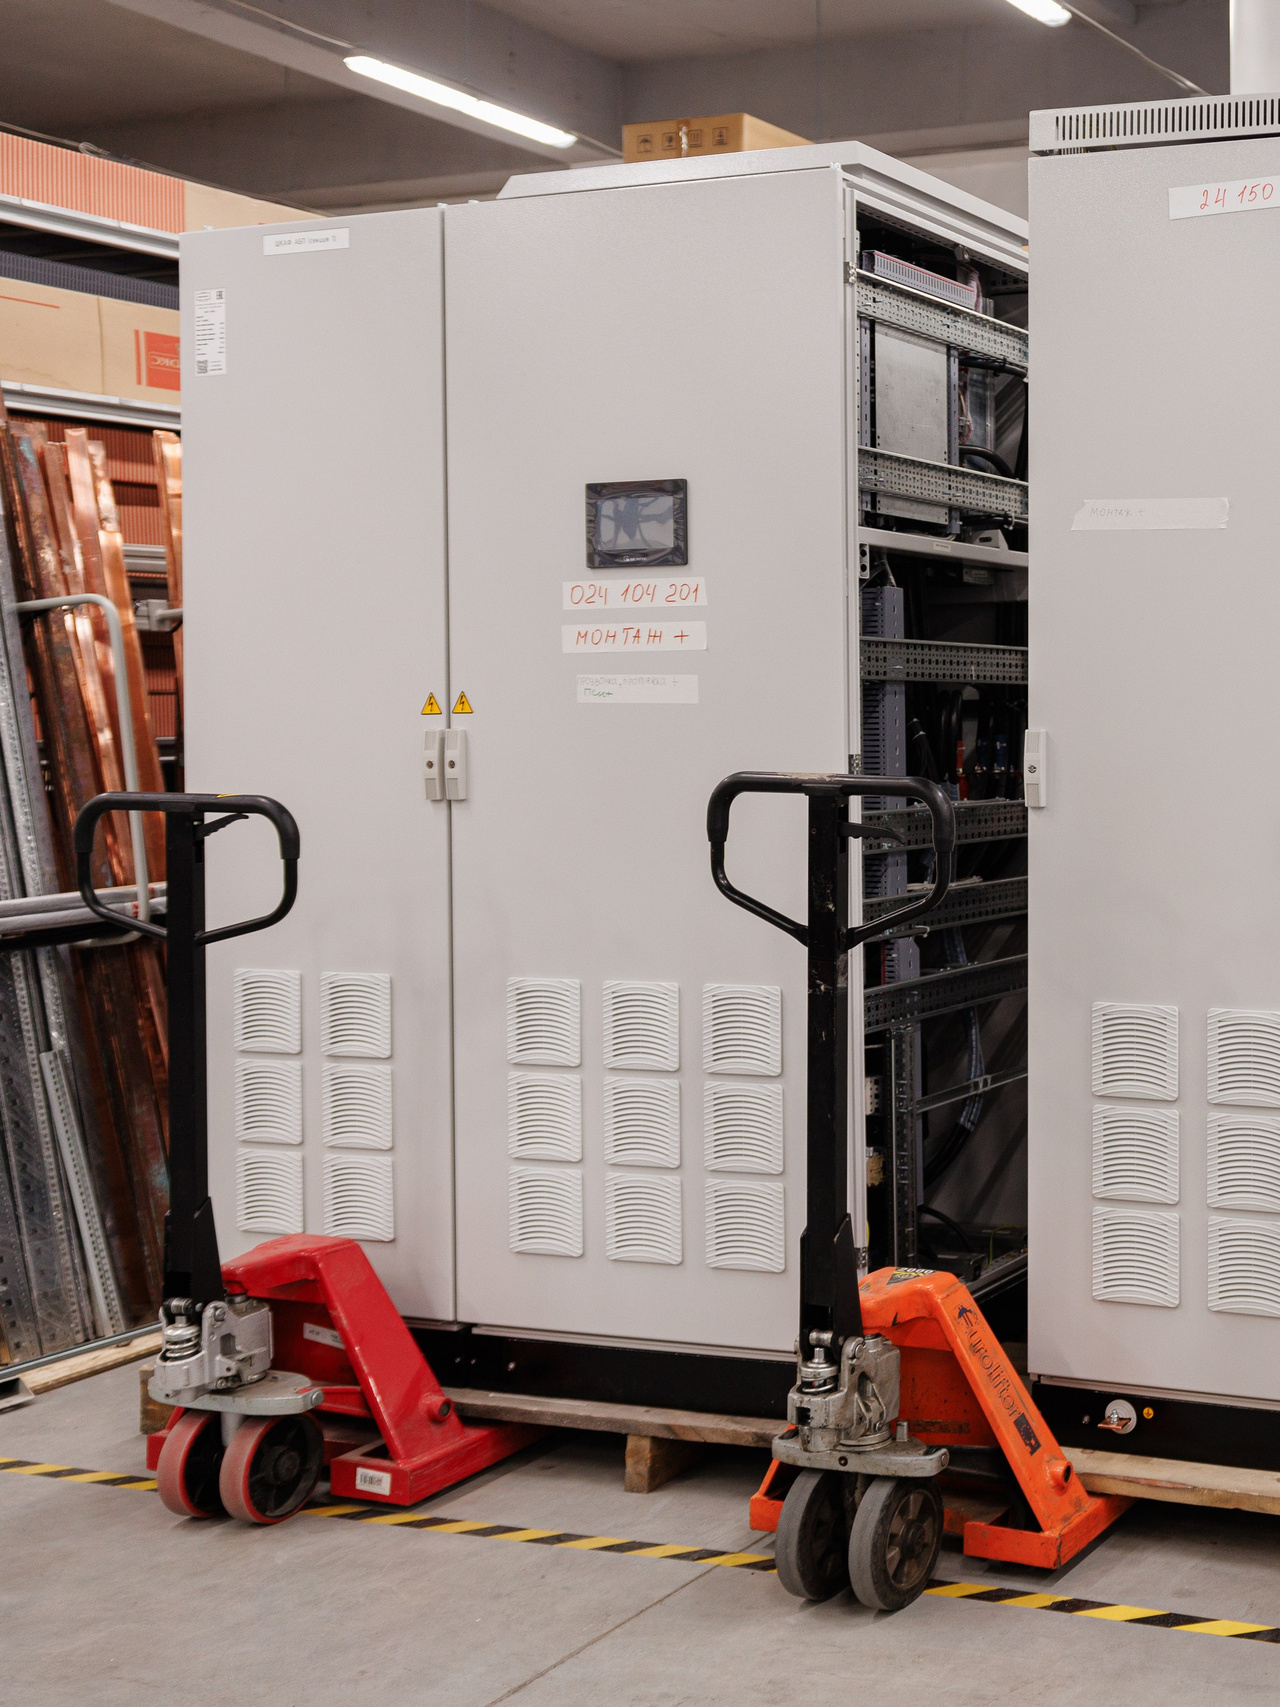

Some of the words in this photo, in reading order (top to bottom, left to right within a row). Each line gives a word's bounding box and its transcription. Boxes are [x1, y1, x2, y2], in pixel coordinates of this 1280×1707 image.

[1199, 187, 1227, 210] 24
[1237, 182, 1274, 204] 150
[570, 584, 608, 605] 024
[621, 583, 657, 603] 104
[665, 583, 699, 603] 201
[575, 627, 663, 645] МОНТАЖ
